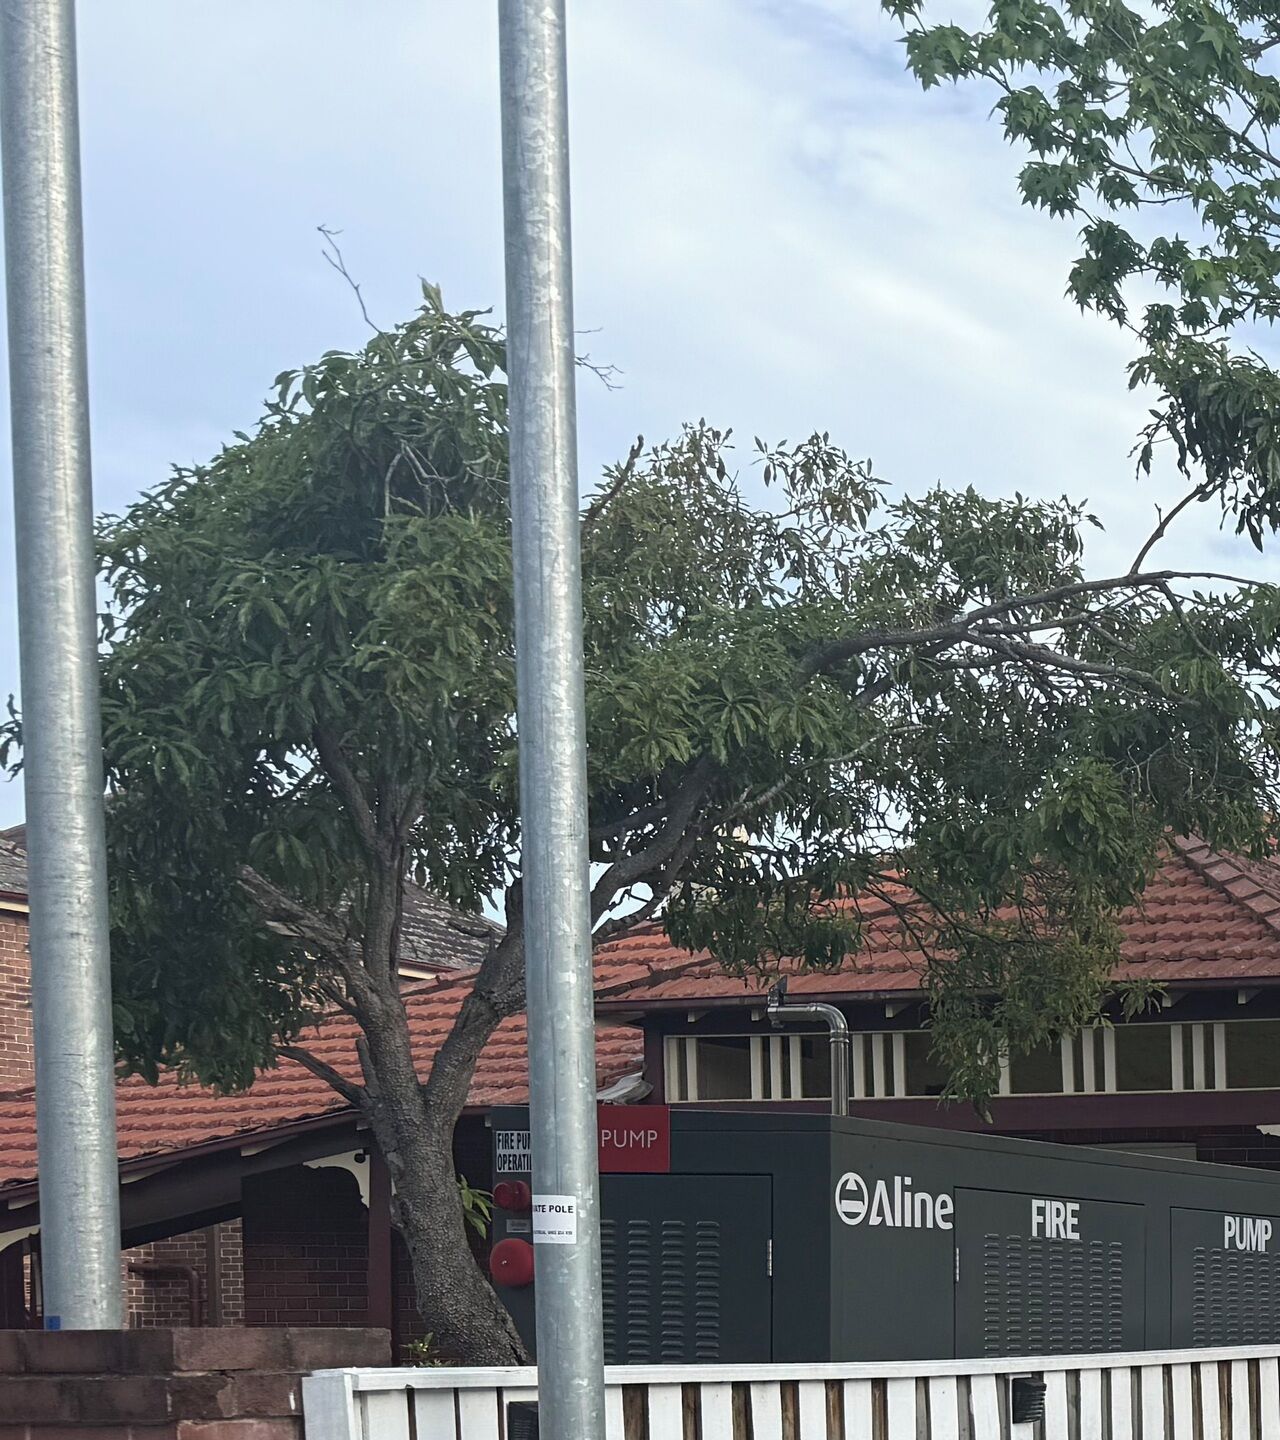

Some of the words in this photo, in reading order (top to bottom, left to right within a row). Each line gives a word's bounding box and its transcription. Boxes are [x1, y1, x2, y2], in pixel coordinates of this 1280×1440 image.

[497, 1132, 514, 1149] FIRE
[516, 1132, 531, 1149] PU
[601, 1129, 658, 1149] PUMP
[548, 1204, 574, 1214] POLE
[868, 1175, 955, 1230] Aline
[1031, 1198, 1081, 1240] FIRE
[1224, 1215, 1273, 1252] PUMP
